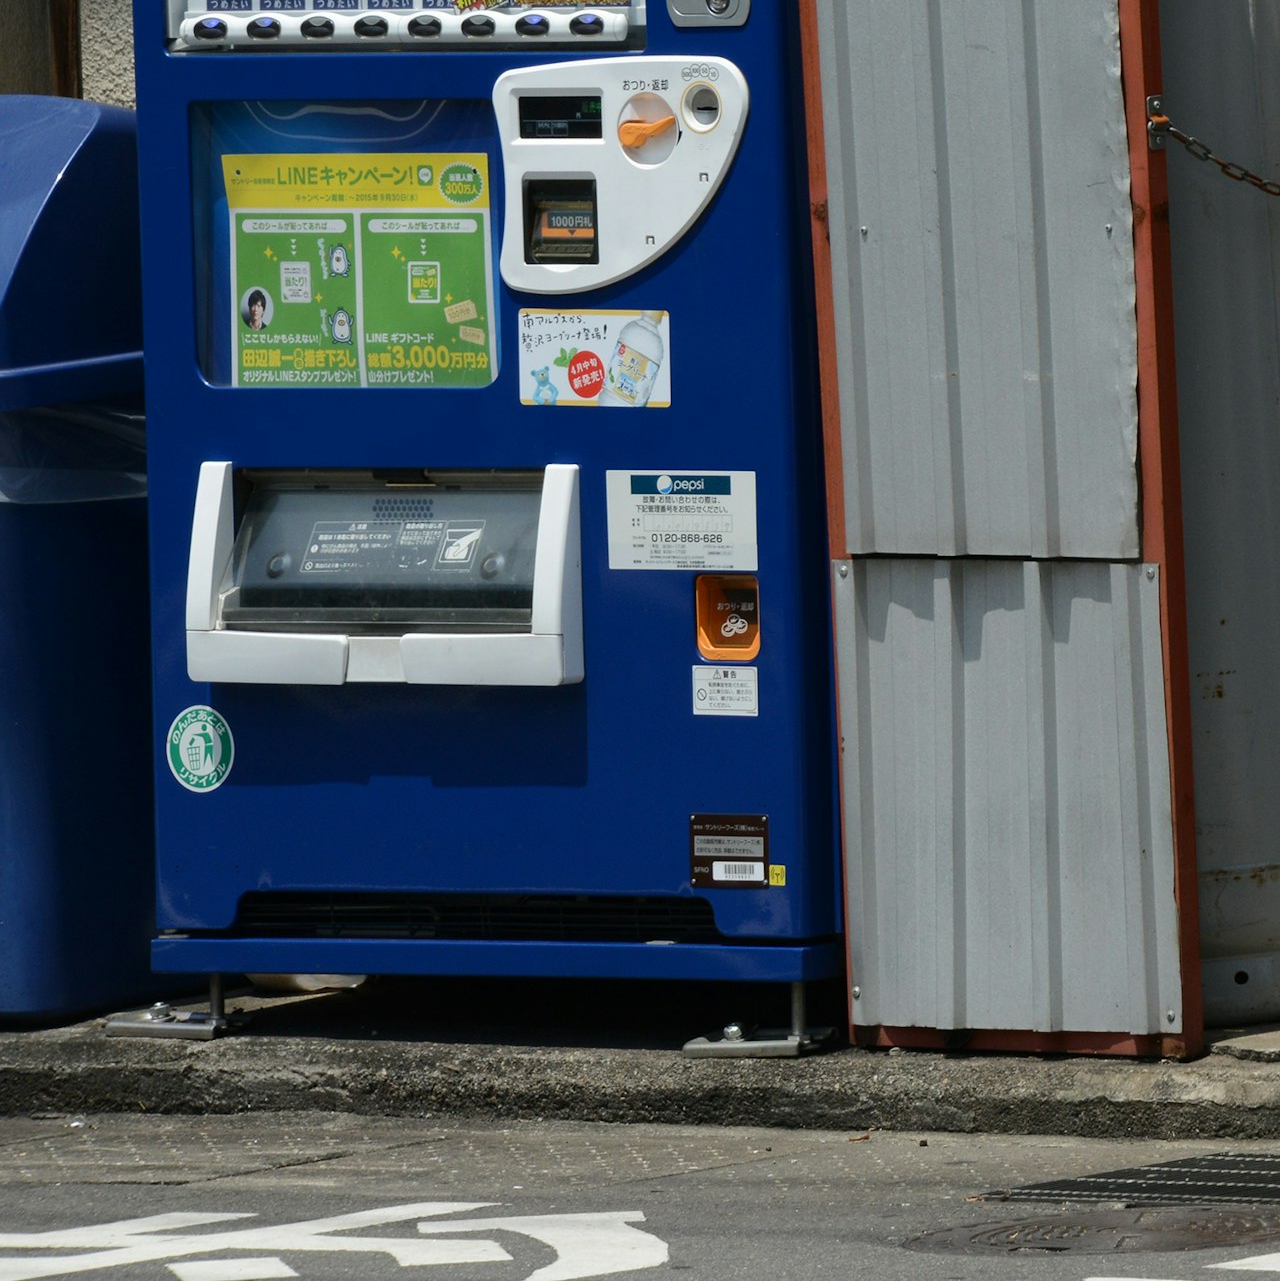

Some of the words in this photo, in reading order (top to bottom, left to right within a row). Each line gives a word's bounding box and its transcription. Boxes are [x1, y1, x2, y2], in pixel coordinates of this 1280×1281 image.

[444, 182, 478, 196] 300万人
[551, 215, 593, 228] 1000円札
[366, 333, 389, 343] LINE
[368, 370, 434, 384] 山分けプレゼント!
[572, 369, 605, 390] 新発売!
[673, 478, 705, 492] pepsi
[651, 533, 723, 543] 0120-868-626
[179, 762, 226, 787] リサイクル
